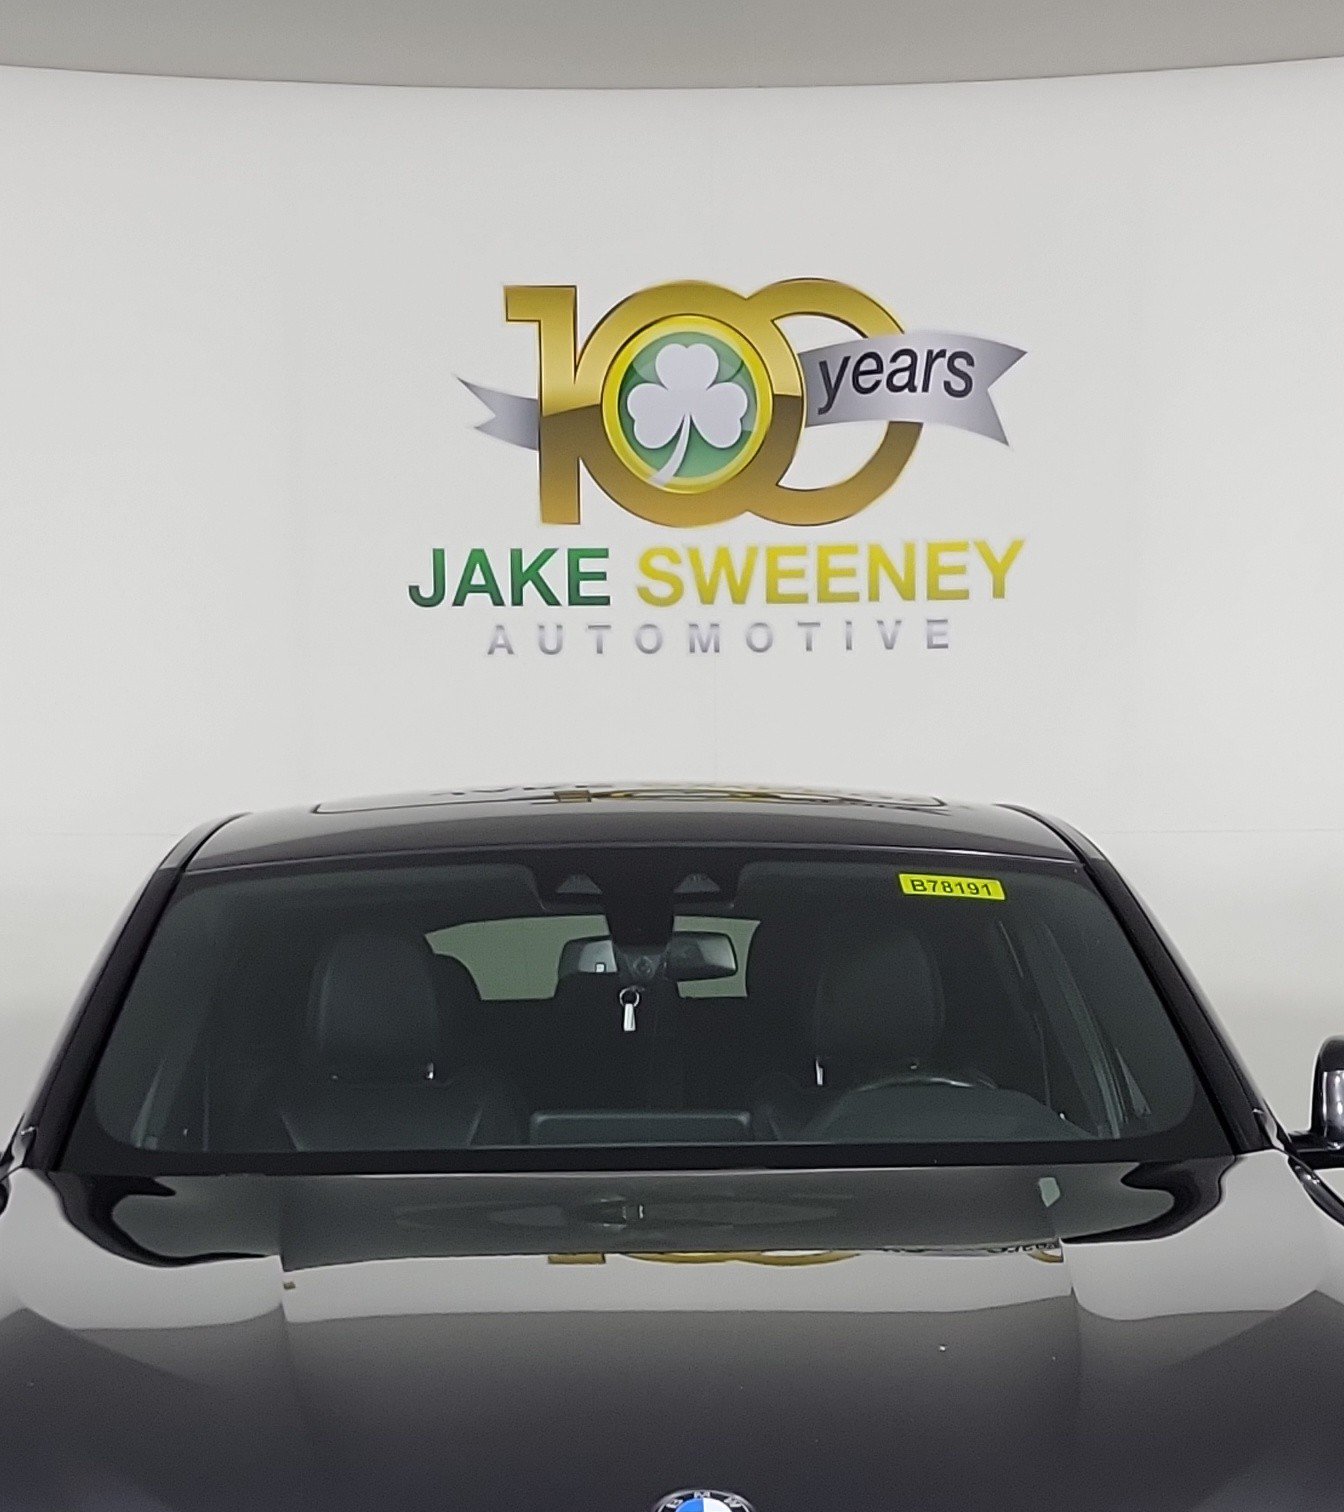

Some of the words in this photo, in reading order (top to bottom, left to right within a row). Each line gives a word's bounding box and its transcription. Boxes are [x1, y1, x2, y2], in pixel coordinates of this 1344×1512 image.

[503, 277, 924, 528] 100
[816, 346, 976, 416] years
[407, 546, 611, 609] JAKE
[635, 539, 1026, 607] SWEENEY
[486, 618, 950, 657] AUTOMOTIVE
[909, 879, 992, 896] B78191
